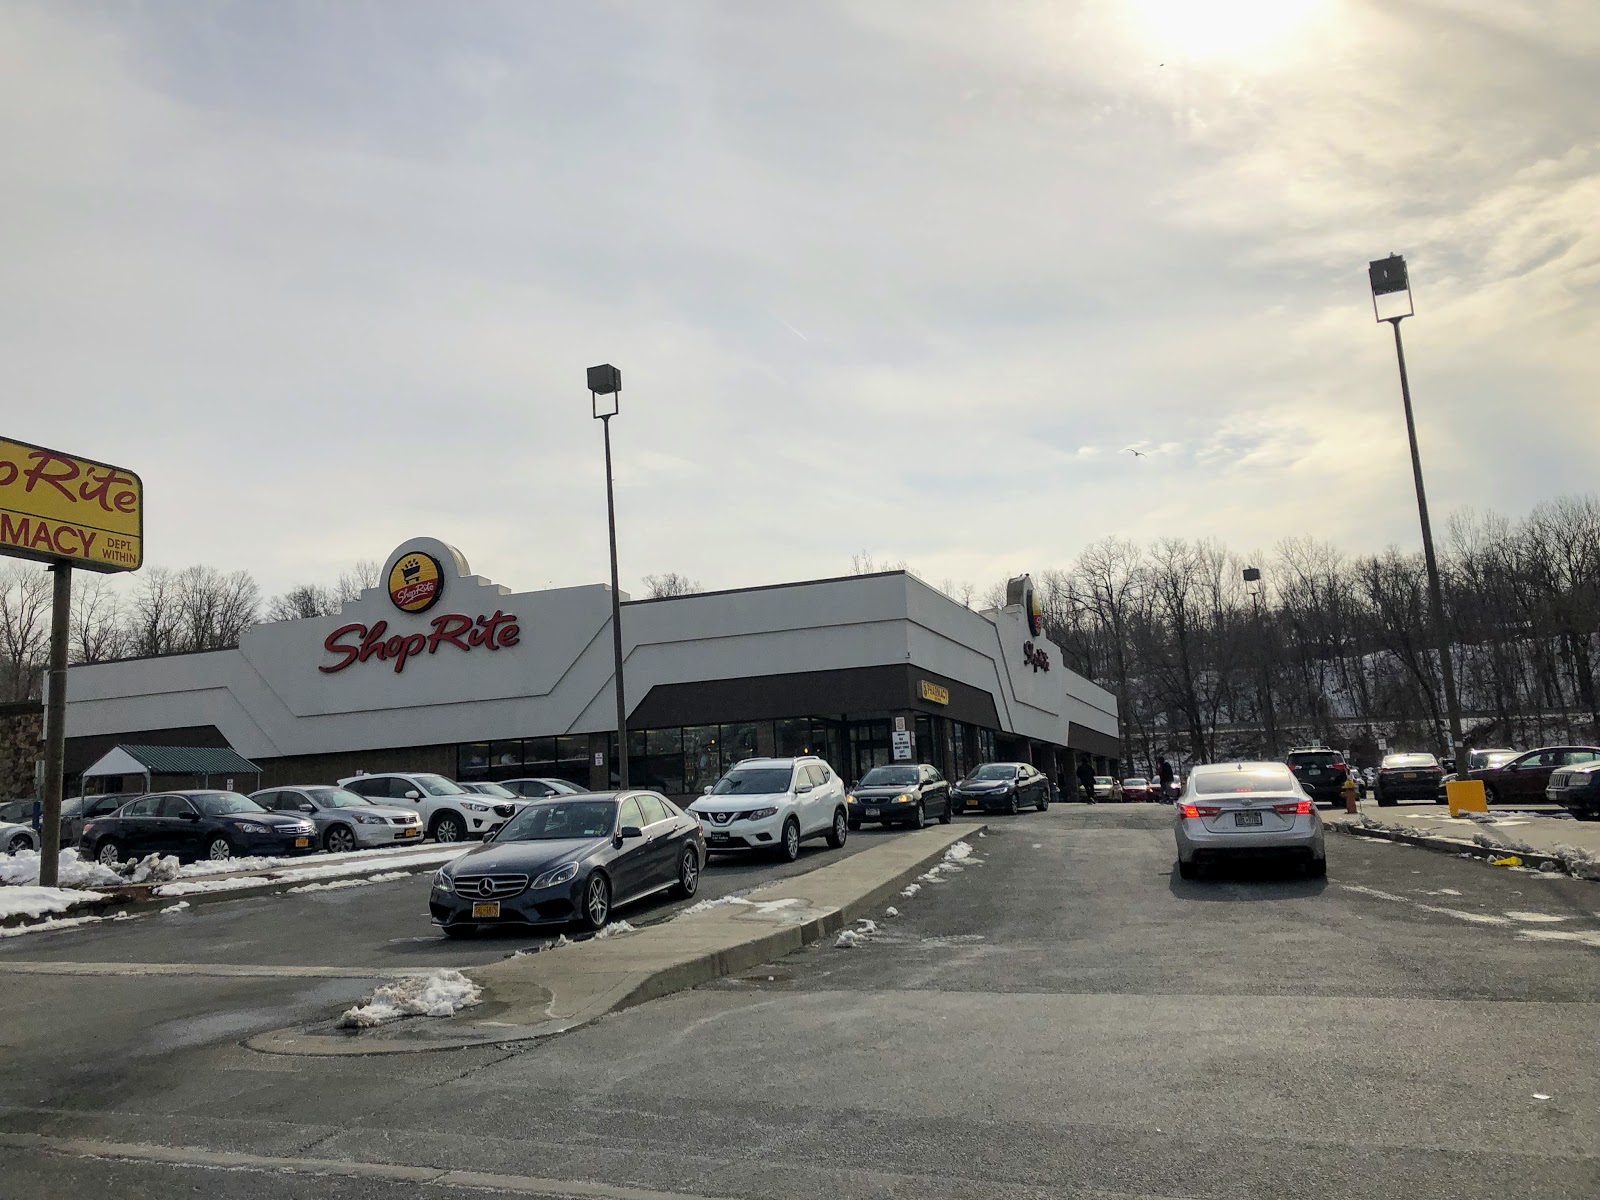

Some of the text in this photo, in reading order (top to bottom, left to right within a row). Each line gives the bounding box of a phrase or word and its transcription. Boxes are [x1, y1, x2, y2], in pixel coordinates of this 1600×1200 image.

[0, 513, 97, 558] MACY
[107, 537, 132, 552] DEPT.
[102, 548, 137, 564] WITHIN
[397, 581, 434, 604] ShopRite
[318, 609, 520, 674] ShopRite
